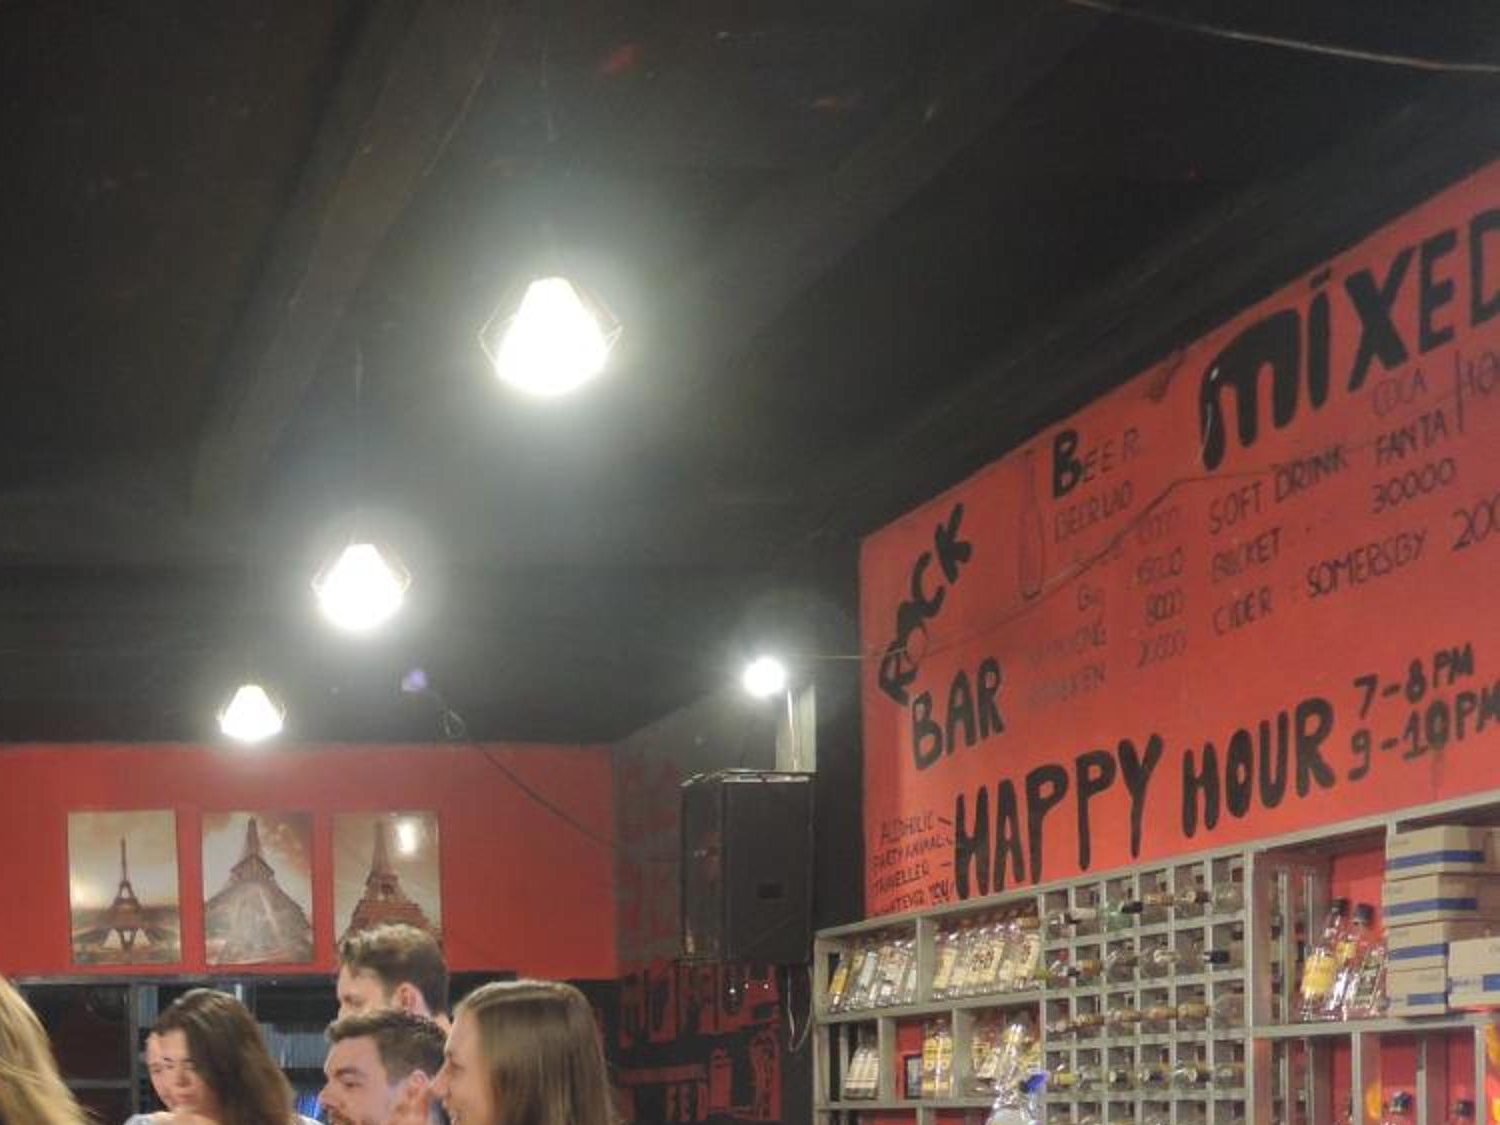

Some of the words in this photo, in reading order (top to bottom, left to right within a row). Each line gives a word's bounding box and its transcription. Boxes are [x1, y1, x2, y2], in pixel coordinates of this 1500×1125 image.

[1208, 480, 1263, 535] SOFT
[911, 656, 1004, 770] BAR
[955, 734, 1165, 900] HAPPY
[1182, 697, 1336, 839] HOUR
